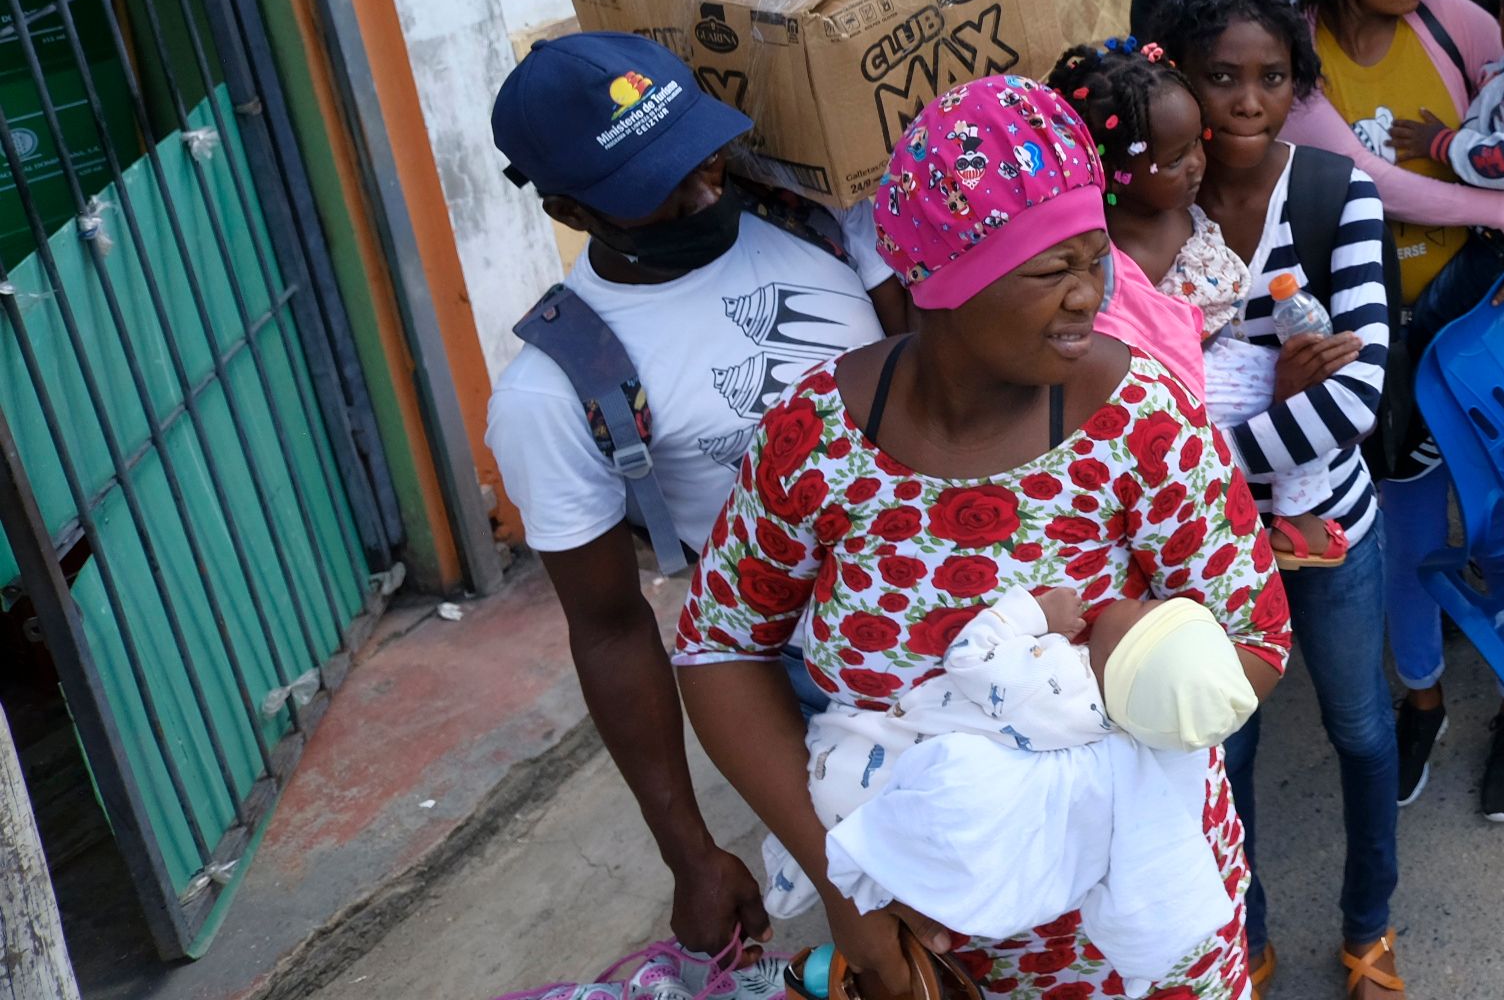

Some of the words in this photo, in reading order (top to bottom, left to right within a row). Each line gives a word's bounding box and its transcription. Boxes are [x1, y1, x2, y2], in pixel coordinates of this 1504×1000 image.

[861, 4, 944, 83] CLUB
[874, 3, 1019, 154] MAX
[596, 109, 643, 146] Ministerio
[642, 100, 656, 114] de
[651, 80, 678, 104] Turismo
[635, 107, 669, 135] CEIZTUR
